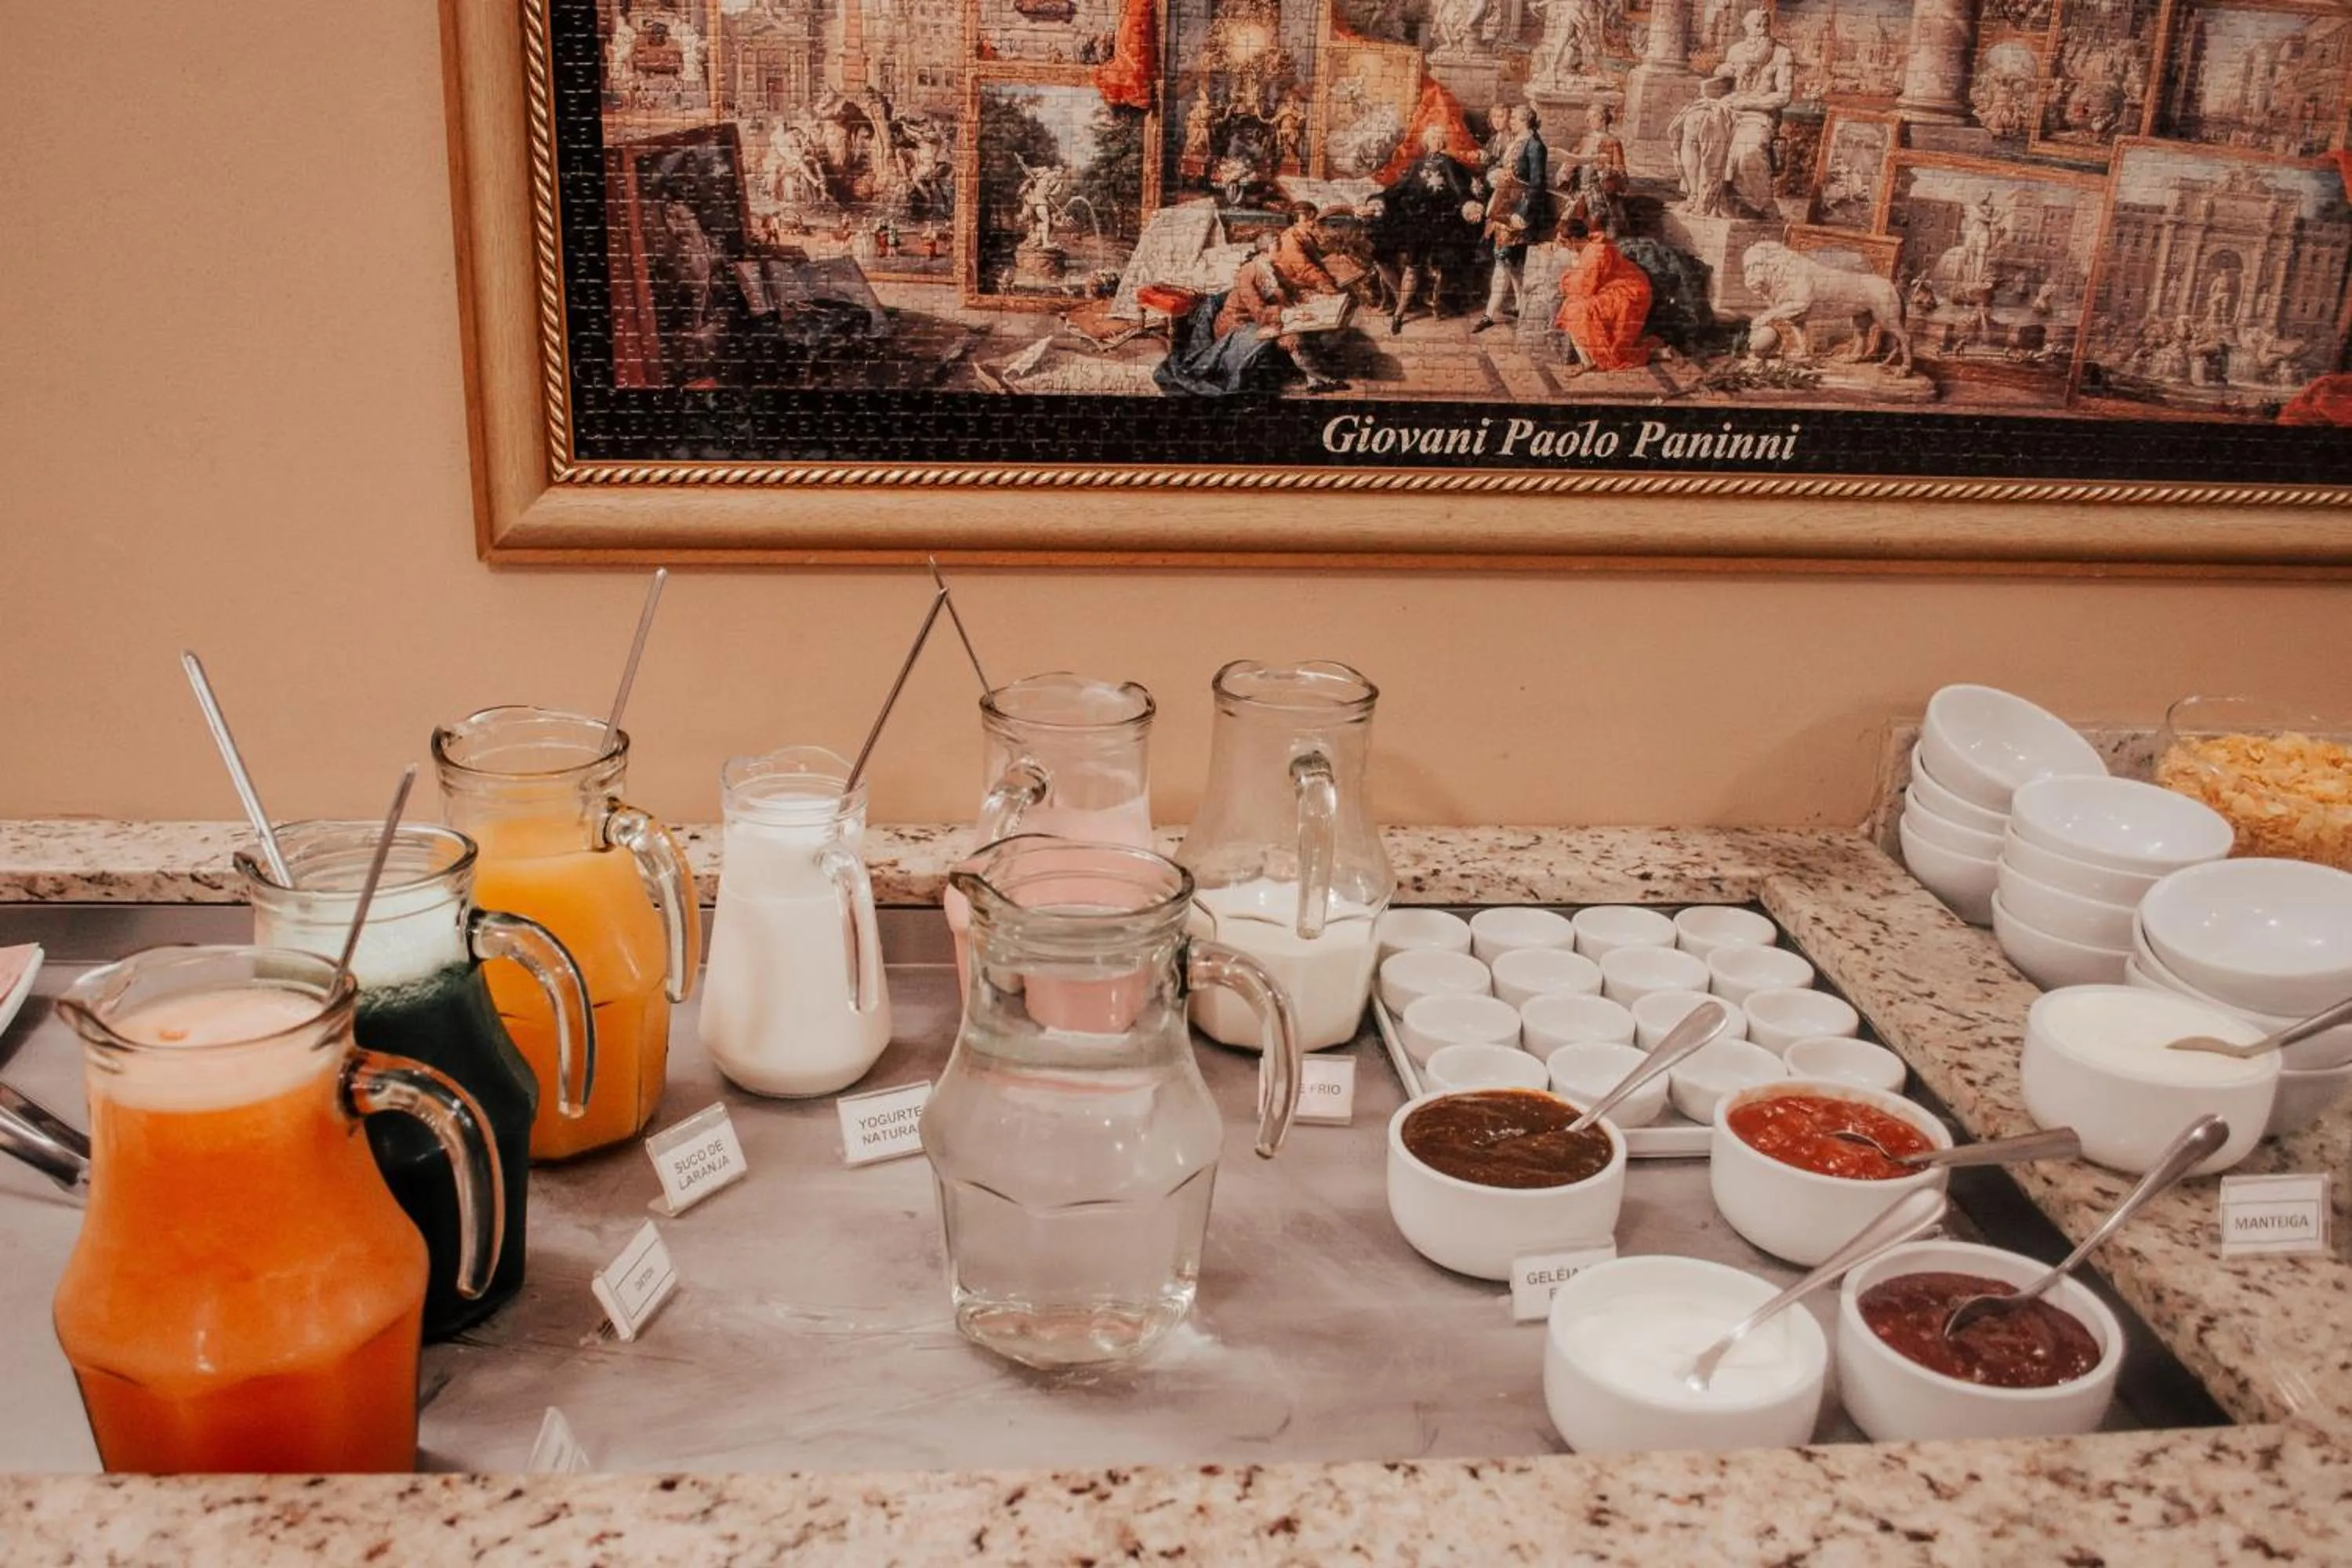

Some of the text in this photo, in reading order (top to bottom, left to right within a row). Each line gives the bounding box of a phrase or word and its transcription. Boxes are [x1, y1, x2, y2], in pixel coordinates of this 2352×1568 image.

[1321, 413, 1801, 462] Giovani Paolo Paninni
[858, 1104, 923, 1130] YOGURTE
[862, 1123, 917, 1145] NATURA
[674, 1138, 724, 1175] SUCO DE
[677, 1155, 730, 1191] LARANJA
[2234, 1214, 2309, 1231] MANTEIGA
